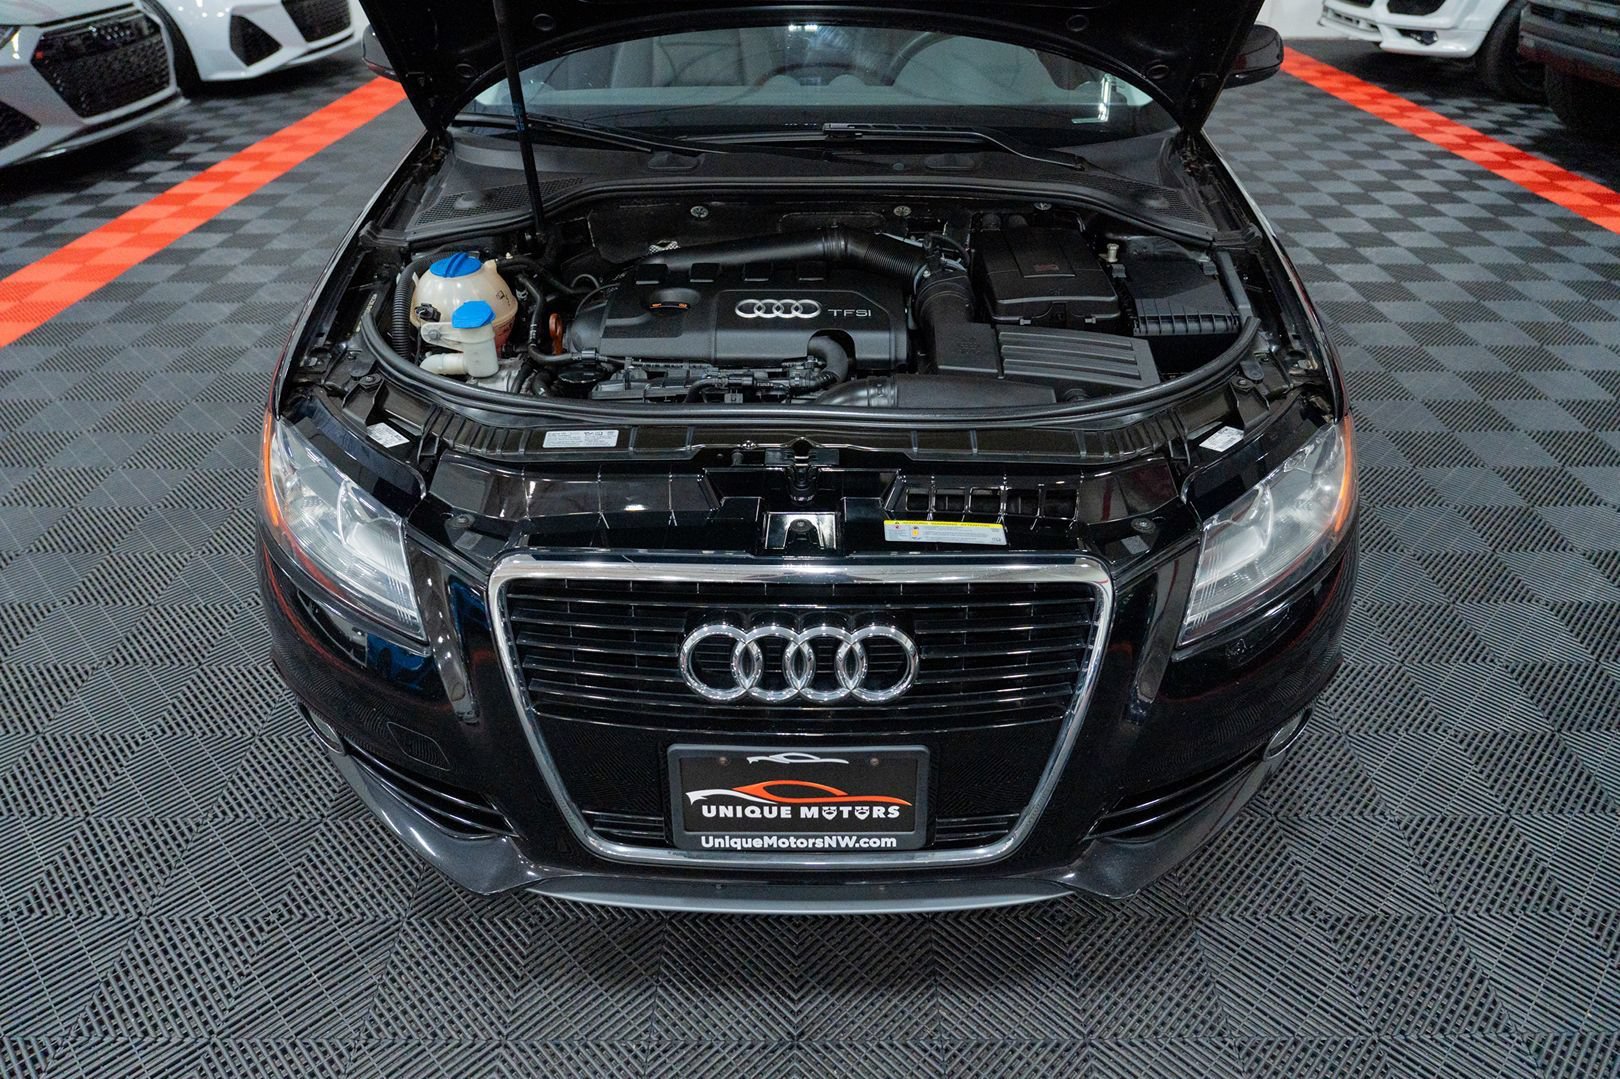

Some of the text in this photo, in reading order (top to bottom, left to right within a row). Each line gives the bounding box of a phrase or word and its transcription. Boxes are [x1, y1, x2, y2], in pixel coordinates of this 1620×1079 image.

[827, 308, 872, 317] TFSI
[701, 805, 901, 821] UNIQUE MOTORS
[701, 835, 897, 850] UniqueMotorsNW.com
